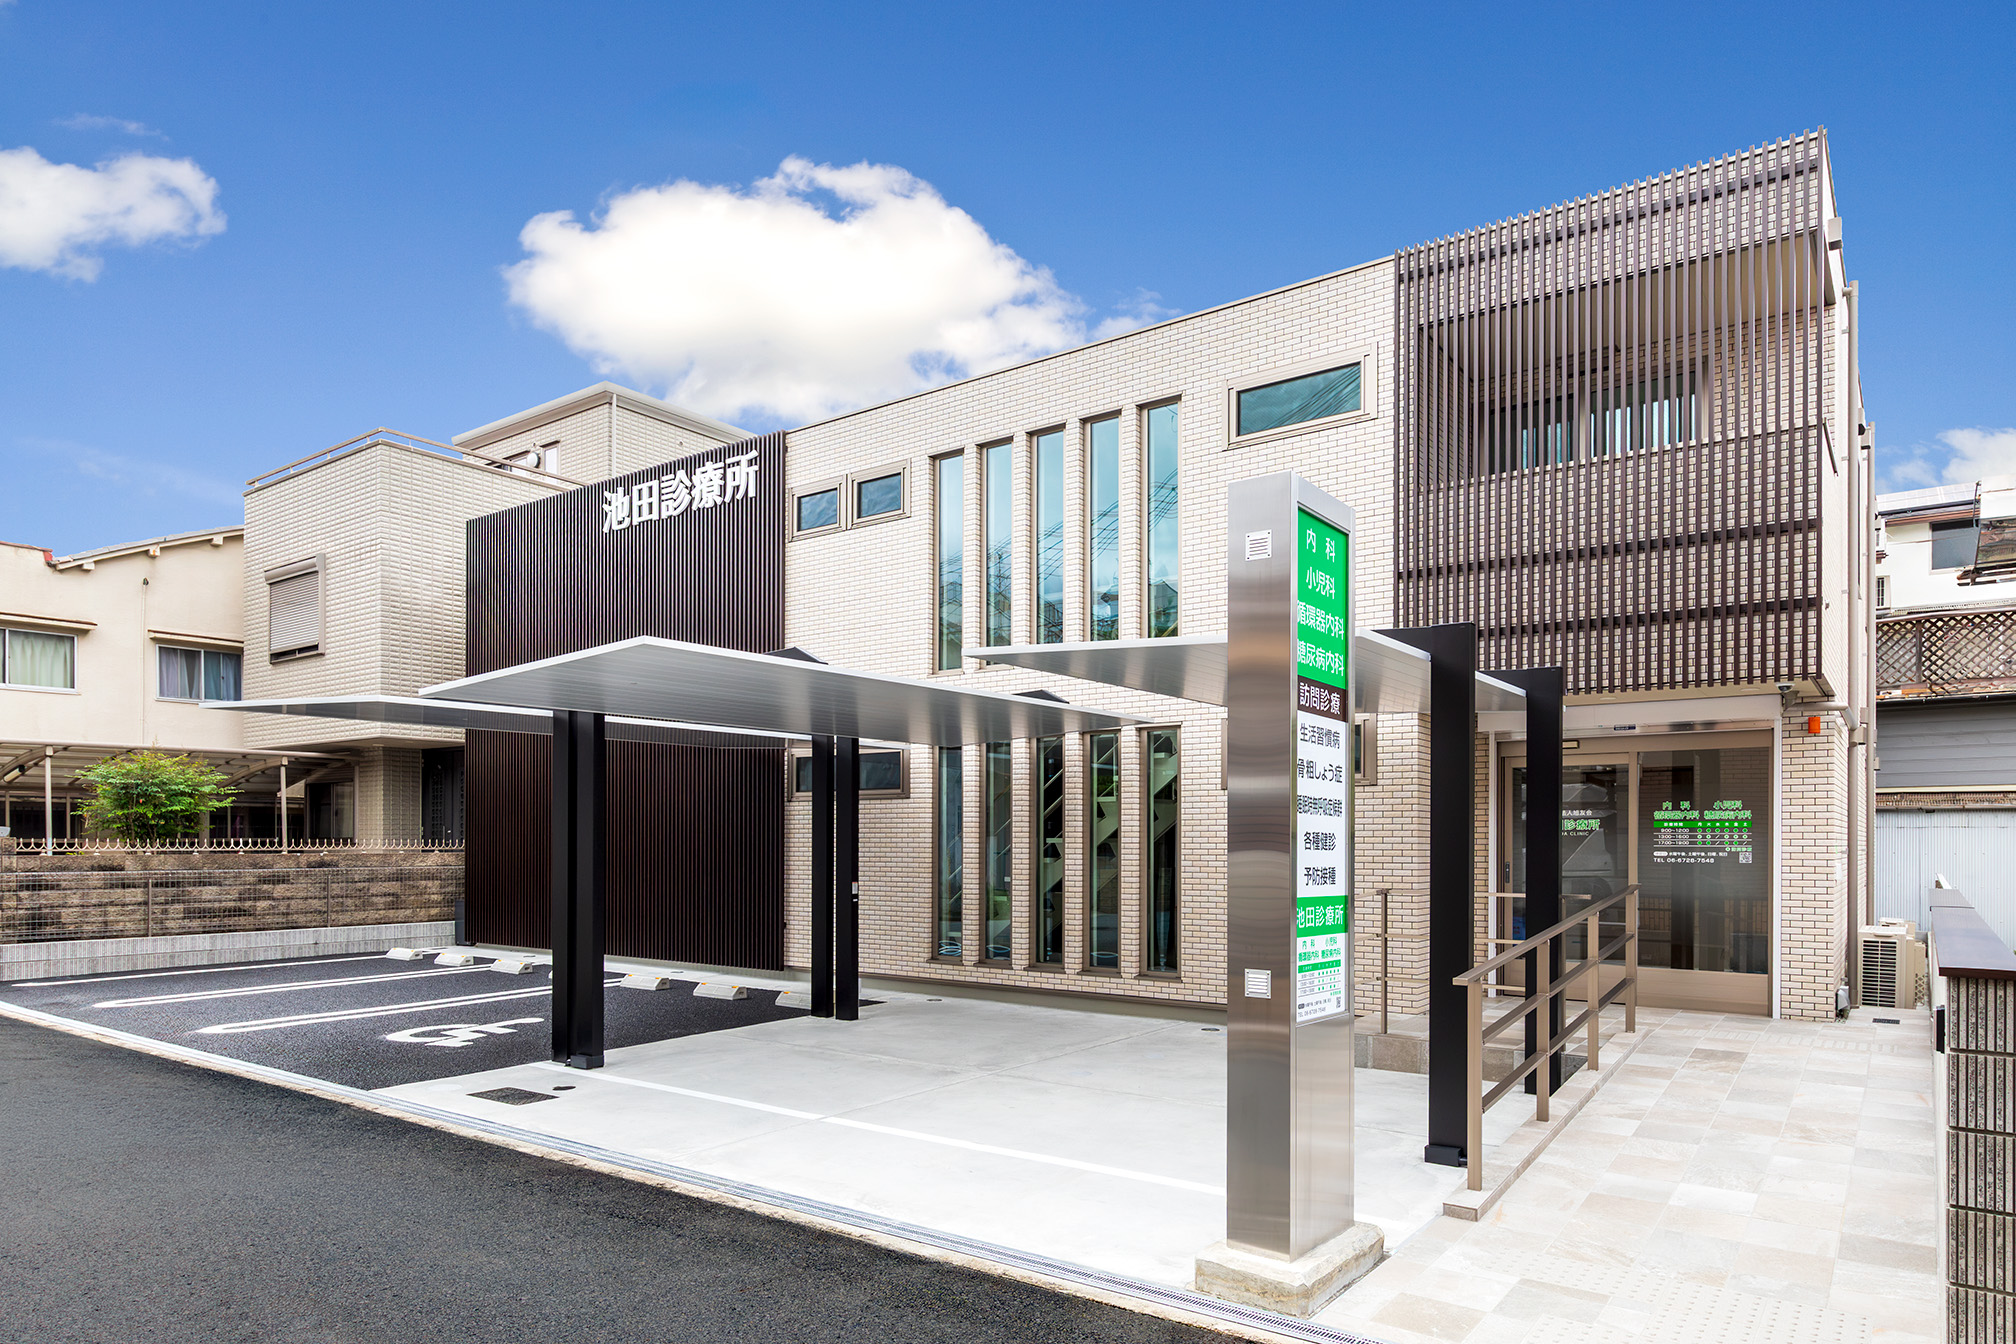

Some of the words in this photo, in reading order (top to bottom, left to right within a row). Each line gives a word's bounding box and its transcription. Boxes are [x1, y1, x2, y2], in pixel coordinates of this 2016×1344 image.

[602, 449, 759, 533] 池田診療所
[1306, 528, 1316, 553] 内
[1325, 537, 1335, 562] 科
[1306, 566, 1335, 599] 小児科
[1300, 682, 1341, 715] 訪問診療
[1300, 723, 1340, 749] 生活習慣病
[1297, 758, 1343, 783] 骨粗しょう症
[1562, 819, 1600, 831] 診療所
[1304, 831, 1337, 851] 各種健診
[1304, 866, 1336, 886] 予防接種
[1297, 905, 1343, 928] 池田診療所
